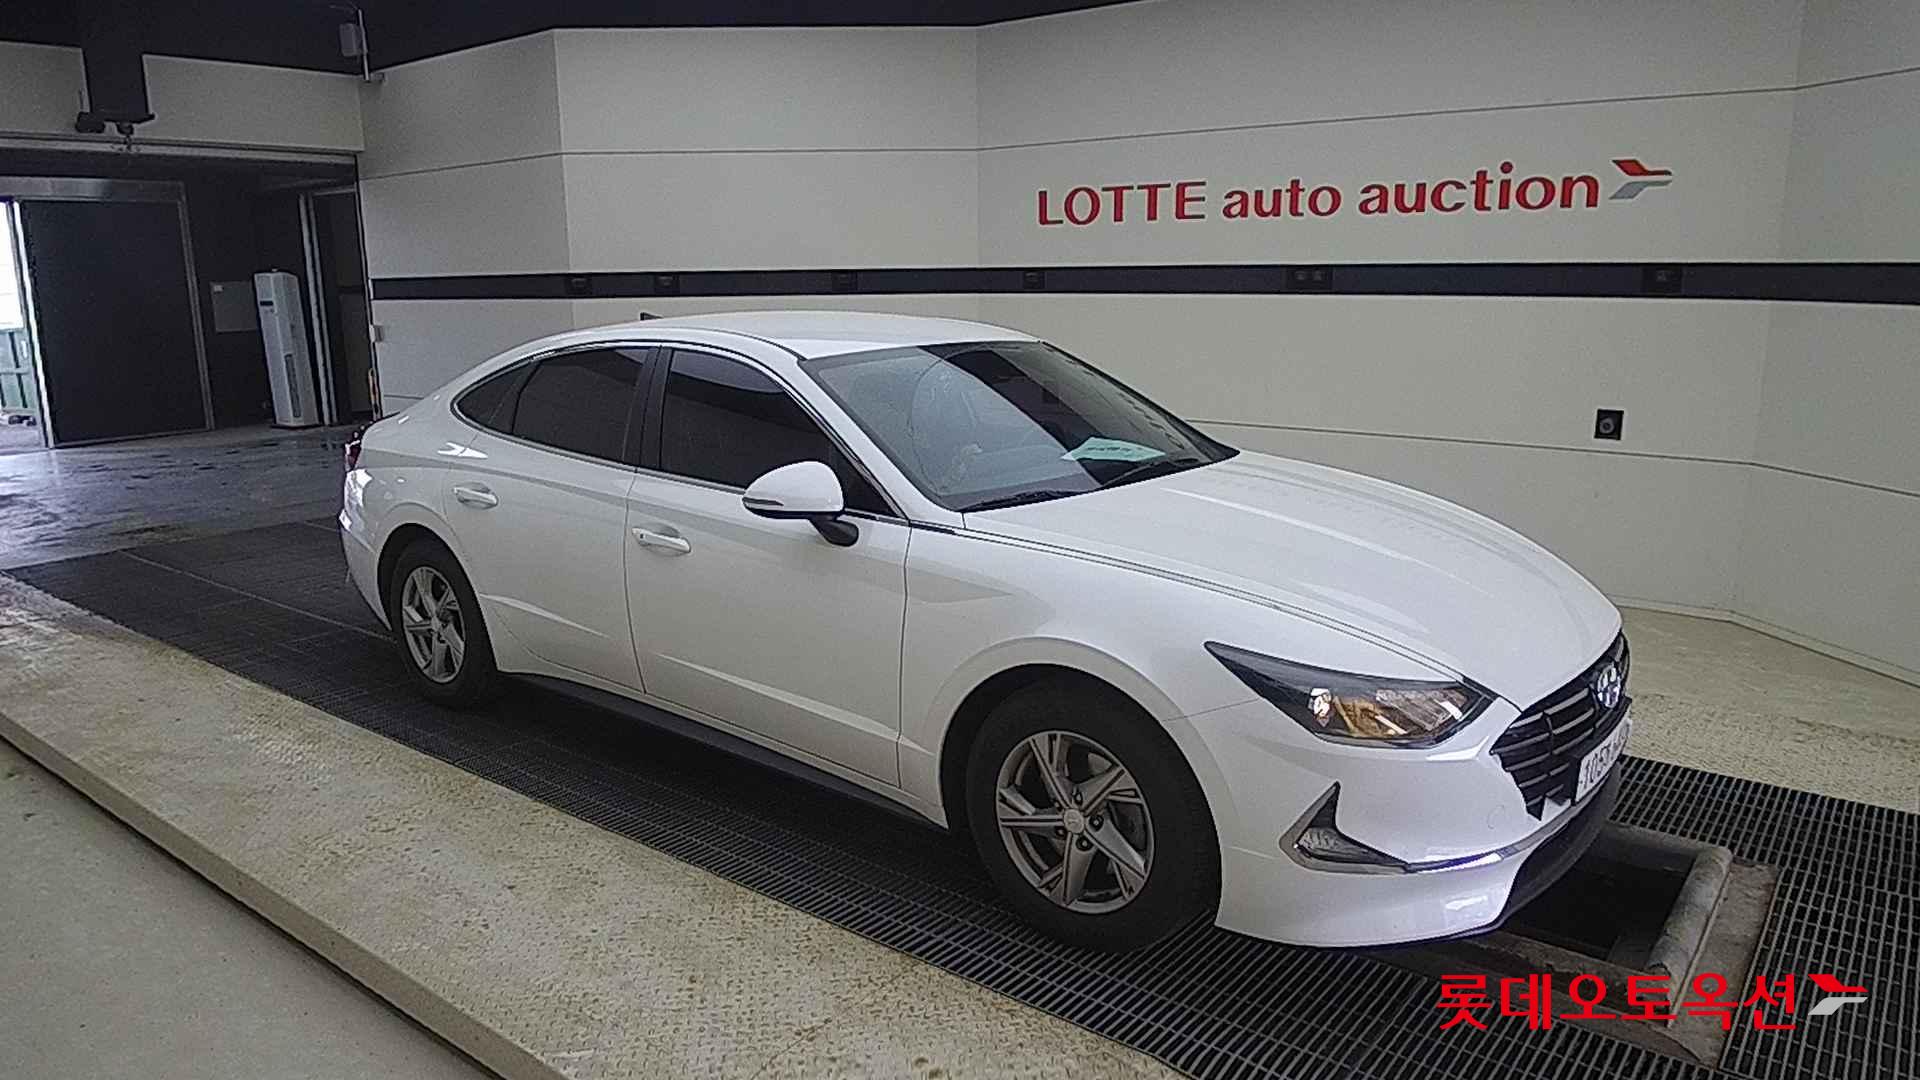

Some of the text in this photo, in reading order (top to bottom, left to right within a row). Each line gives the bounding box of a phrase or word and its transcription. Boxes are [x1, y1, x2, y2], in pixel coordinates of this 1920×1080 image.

[1038, 161, 1600, 226] LOTTE auto auction
